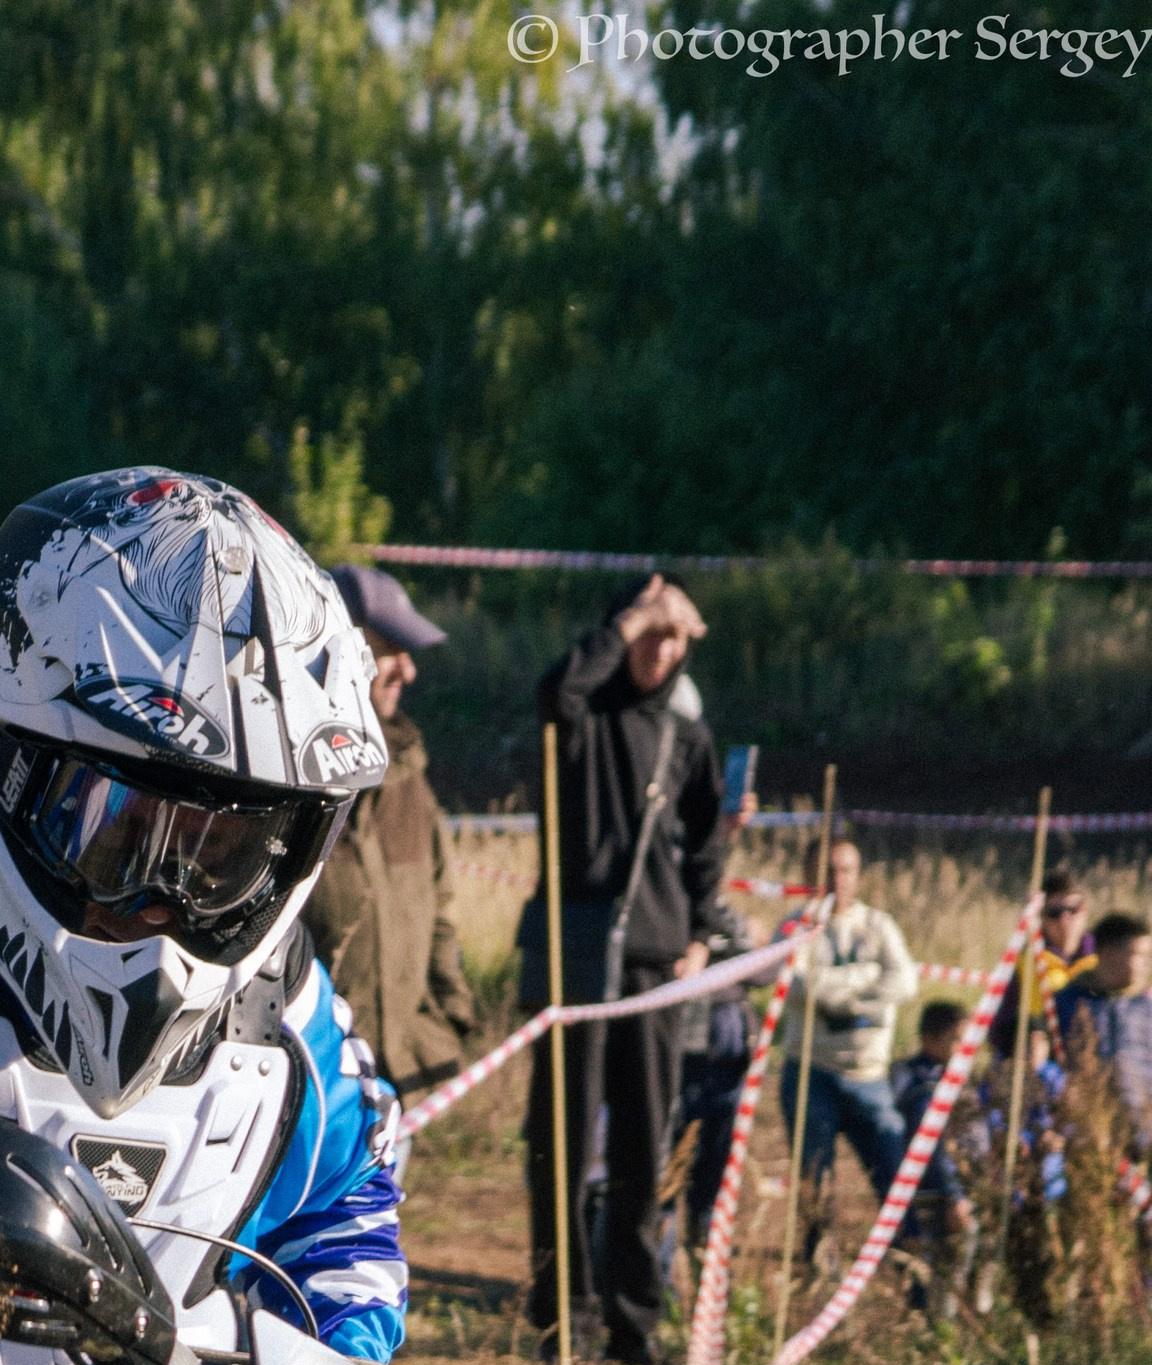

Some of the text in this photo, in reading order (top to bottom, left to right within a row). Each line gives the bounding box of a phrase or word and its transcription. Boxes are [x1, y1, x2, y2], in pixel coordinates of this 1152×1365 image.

[87, 684, 210, 755] Airoh
[0, 747, 29, 814] LEATT
[311, 729, 385, 783] Airoh
